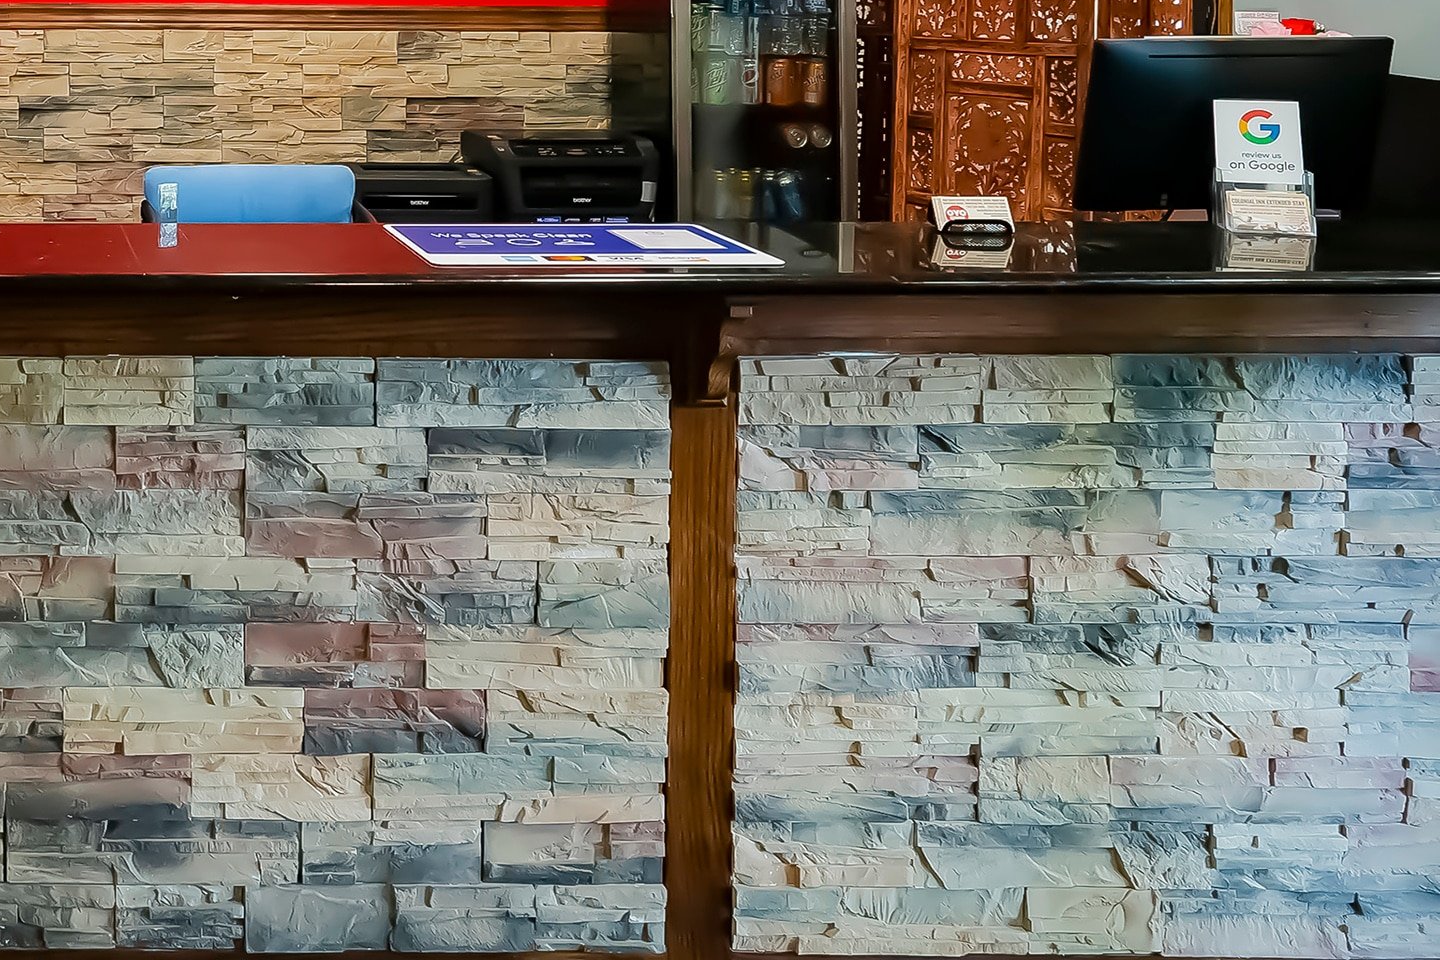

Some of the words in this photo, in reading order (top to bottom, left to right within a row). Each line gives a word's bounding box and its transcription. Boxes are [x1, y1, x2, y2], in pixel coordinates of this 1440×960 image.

[1241, 151, 1270, 159] review
[1229, 161, 1246, 169] on
[1248, 159, 1296, 173] Google
[946, 209, 967, 217] OYO
